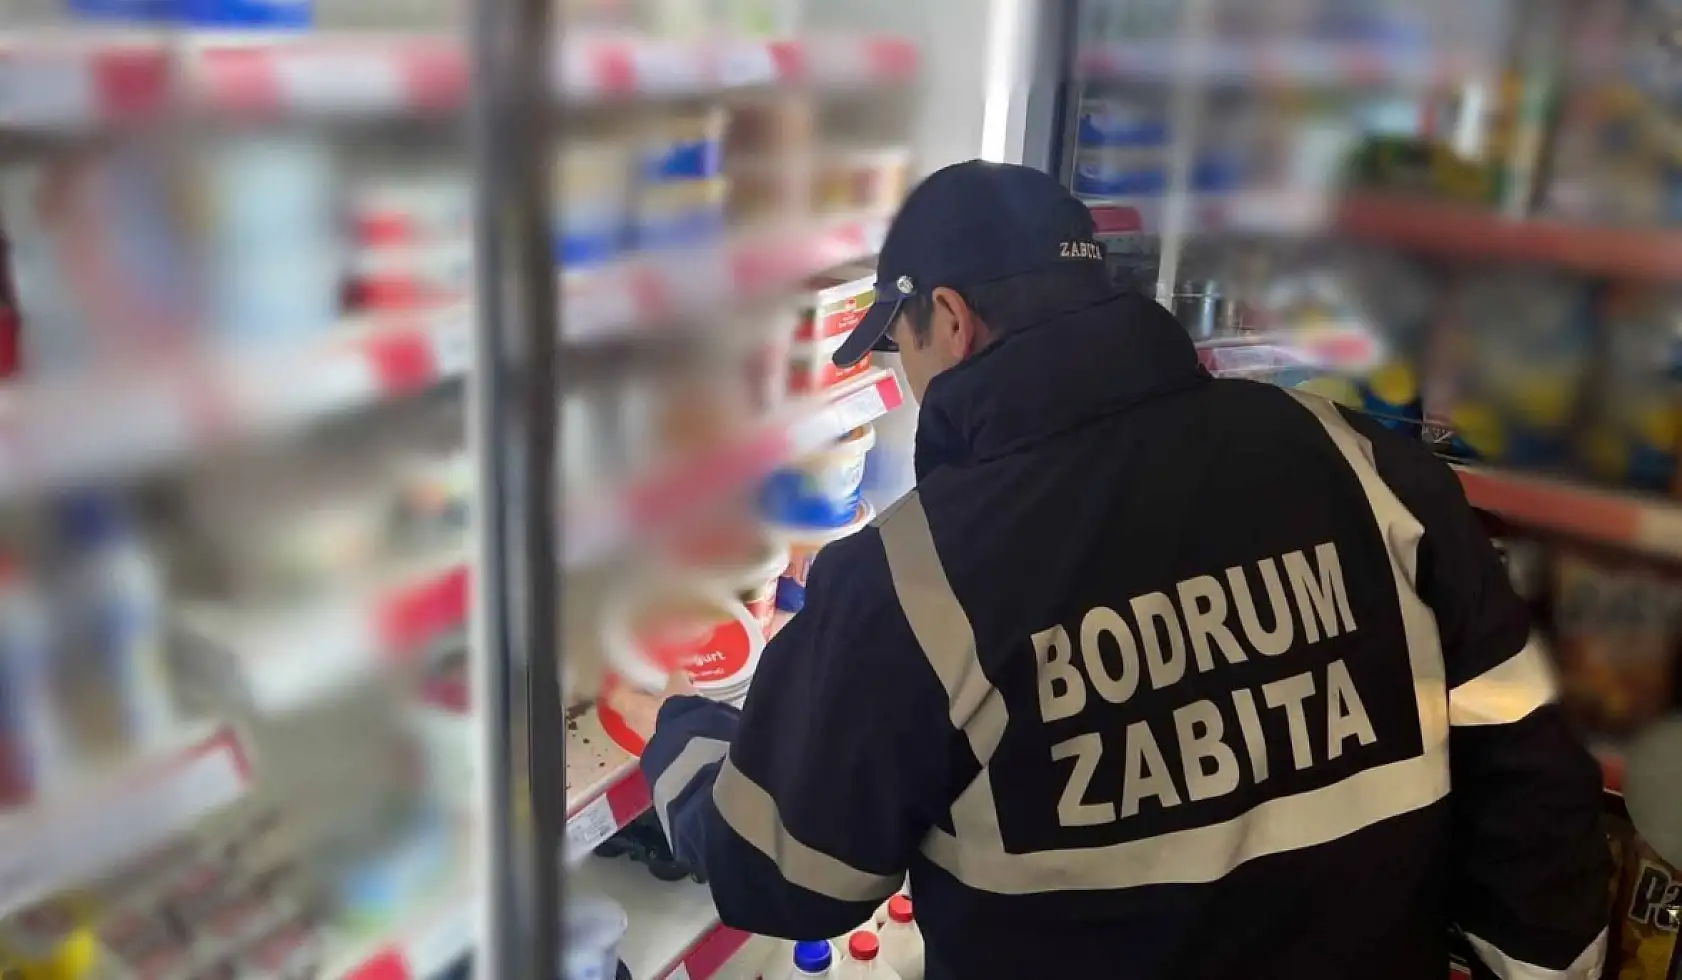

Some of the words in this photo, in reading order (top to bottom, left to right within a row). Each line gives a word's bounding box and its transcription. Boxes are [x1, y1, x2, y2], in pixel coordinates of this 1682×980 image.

[1059, 240, 1103, 260] ZABITA
[1030, 541, 1357, 723] BODRUM
[1050, 659, 1377, 827] ZABITA
